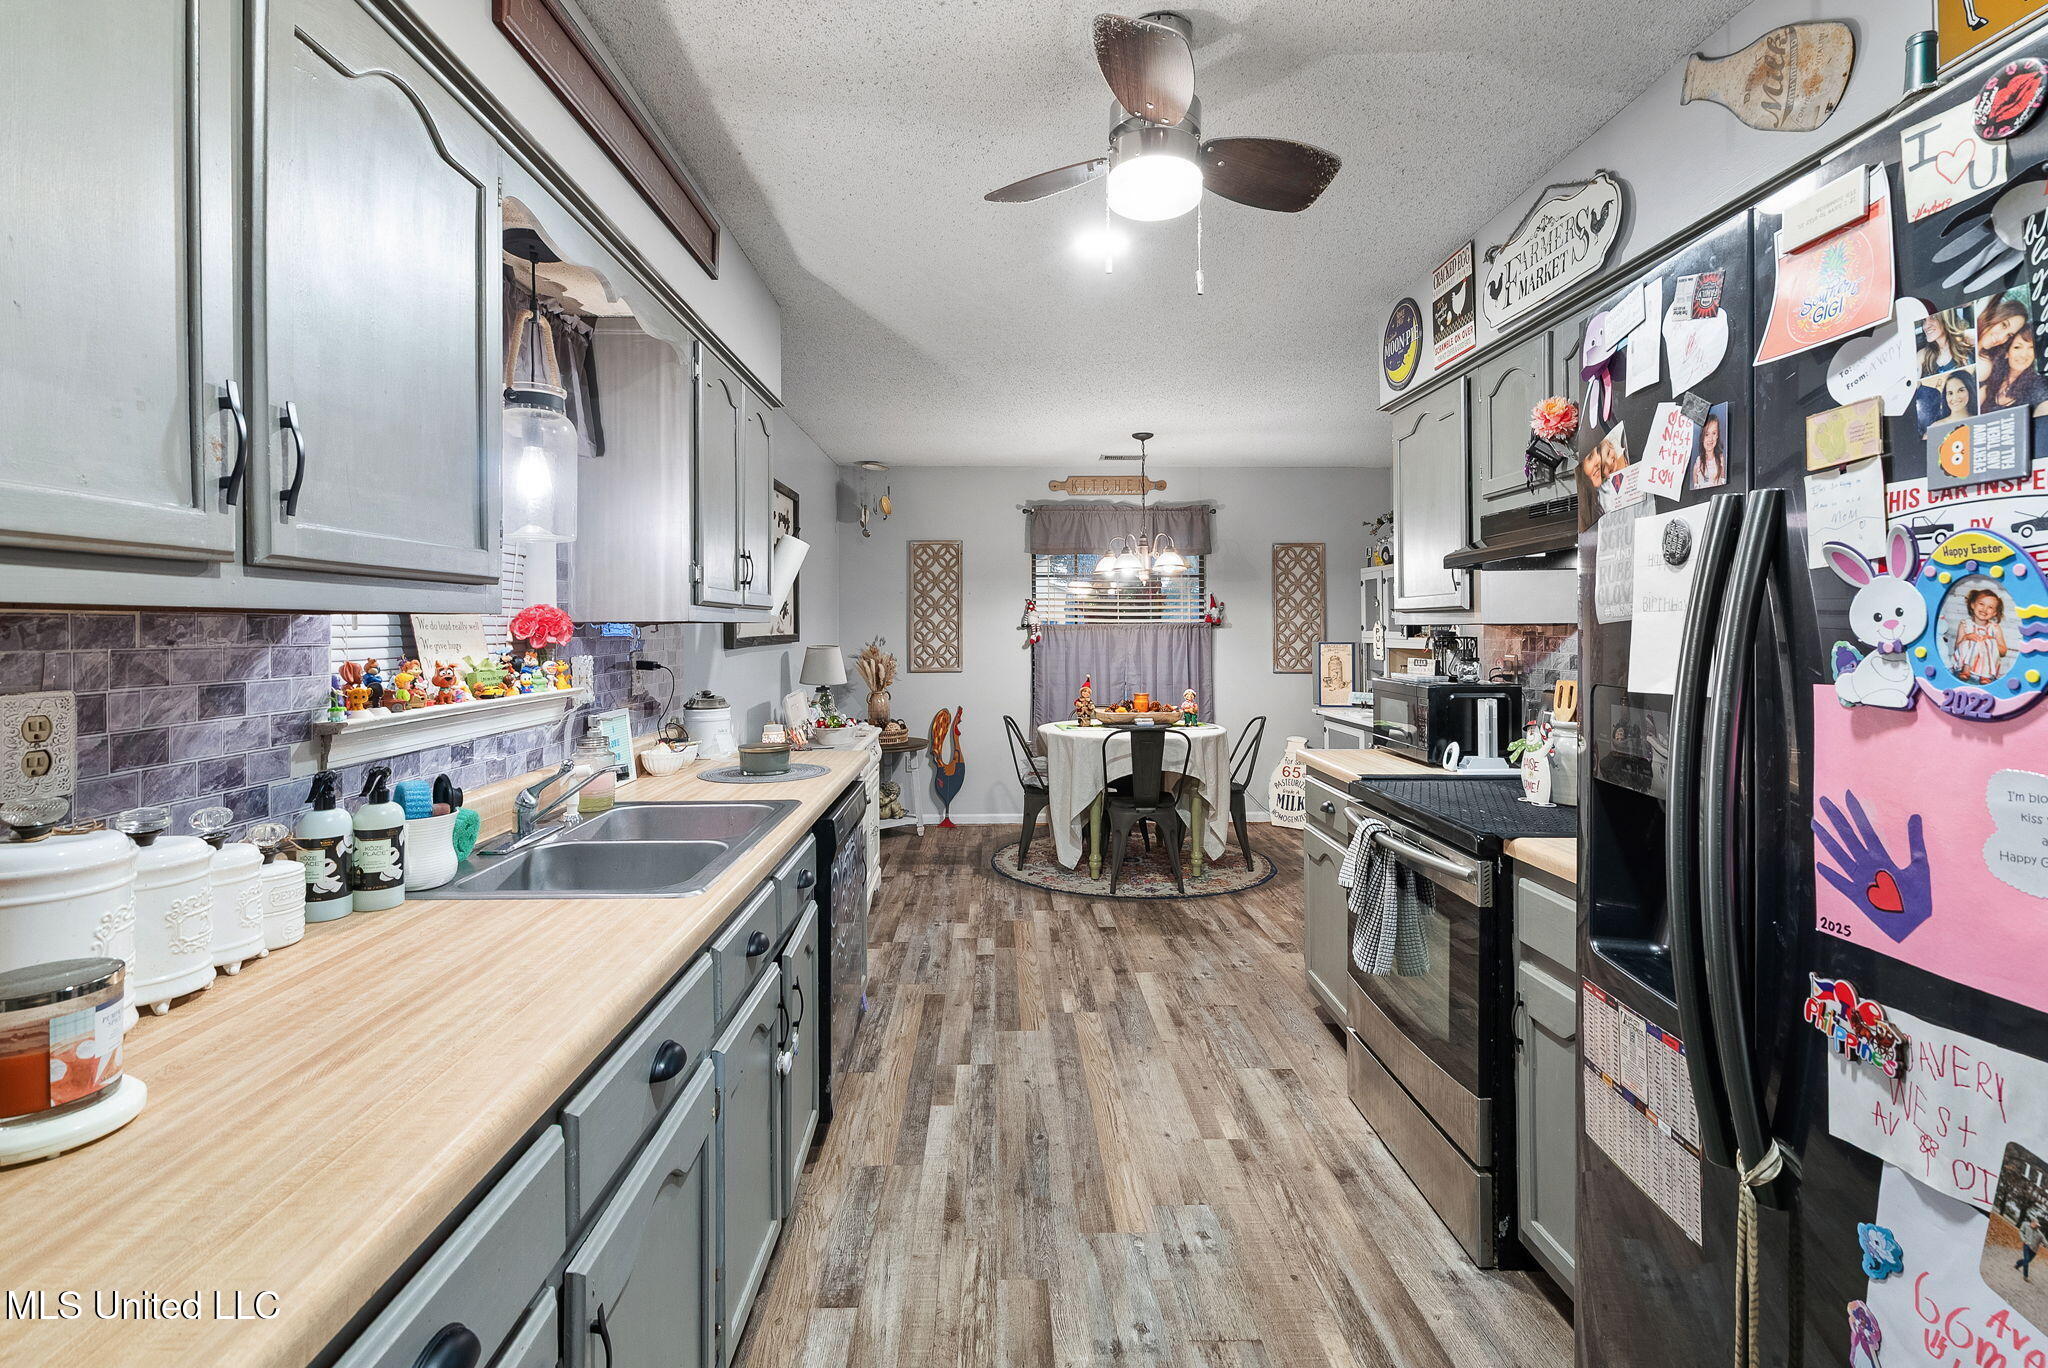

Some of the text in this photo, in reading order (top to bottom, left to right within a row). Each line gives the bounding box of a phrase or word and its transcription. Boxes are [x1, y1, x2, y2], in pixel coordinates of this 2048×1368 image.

[1760, 28, 1791, 129] Milk
[592, 82, 617, 127] This
[621, 122, 642, 161] Day
[1433, 259, 1457, 290] CRACKED
[1457, 247, 1471, 269] EGG
[1496, 206, 1591, 310] FARMERS
[1518, 249, 1569, 300] MARKET
[1812, 297, 1844, 323] GIGI
[1384, 334, 1406, 360] MOON
[1434, 336, 1453, 356] SCRAMBLE
[1454, 333, 1461, 344] ON
[1462, 325, 1474, 339] OVER
[1845, 371, 1869, 391] From:
[1973, 424, 1987, 474] EVERY NOW
[1986, 425, 2001, 451] THEN
[2001, 413, 2015, 470] FALL APART.
[1986, 450, 2001, 470] AND
[1071, 479, 1145, 492] KITCHEN
[1886, 488, 1920, 514] HIS
[1943, 544, 2003, 557] Happy Easter
[415, 616, 429, 630] We
[430, 620, 437, 630] do
[438, 621, 452, 630] loud
[452, 621, 468, 633] really
[1940, 689, 1996, 718] 2022
[1276, 793, 1305, 811] MILK
[2007, 790, 2025, 802] I'm
[2021, 813, 2043, 825] kiss
[1999, 850, 2037, 866] Happy
[1819, 917, 1852, 937] 2025
[1804, 997, 1898, 1077] Philippines
[1919, 1042, 2006, 1123] AVERY
